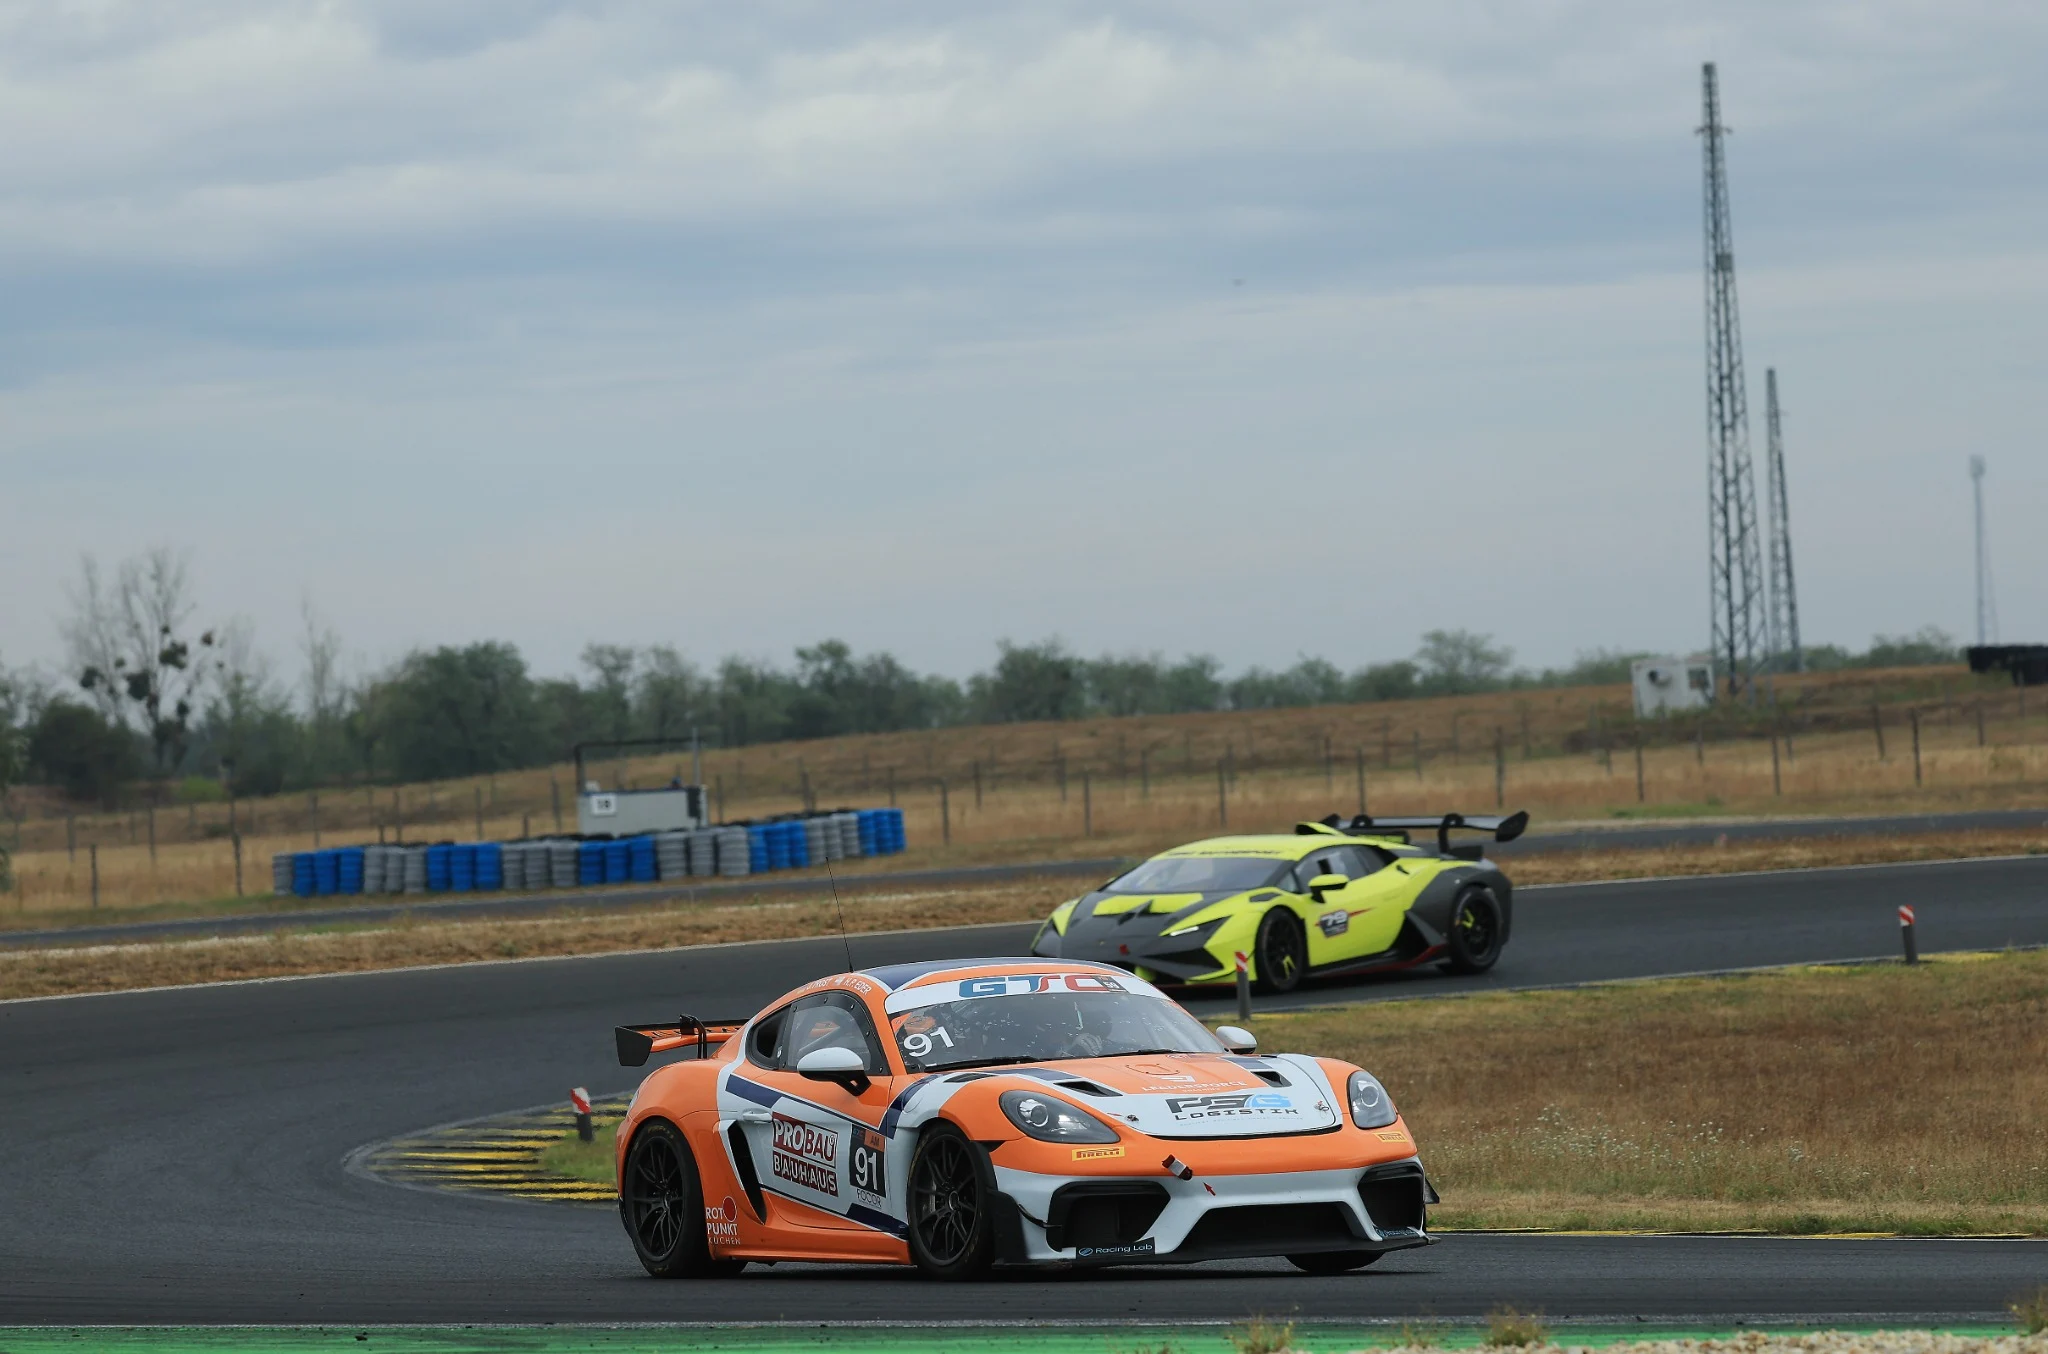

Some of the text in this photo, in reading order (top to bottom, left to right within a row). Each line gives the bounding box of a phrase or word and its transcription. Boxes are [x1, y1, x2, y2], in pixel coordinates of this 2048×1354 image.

[904, 1026, 954, 1057] 91
[1175, 1109, 1299, 1121] LOGISTIK
[870, 1135, 880, 1147] AM
[1076, 1148, 1120, 1158] PIRELLI
[773, 1154, 837, 1192] BAUHAUS
[854, 1147, 878, 1191] 91
[705, 1207, 723, 1220] ROT
[706, 1222, 738, 1236] PUNKT
[1095, 1243, 1153, 1254] Racing Lab
